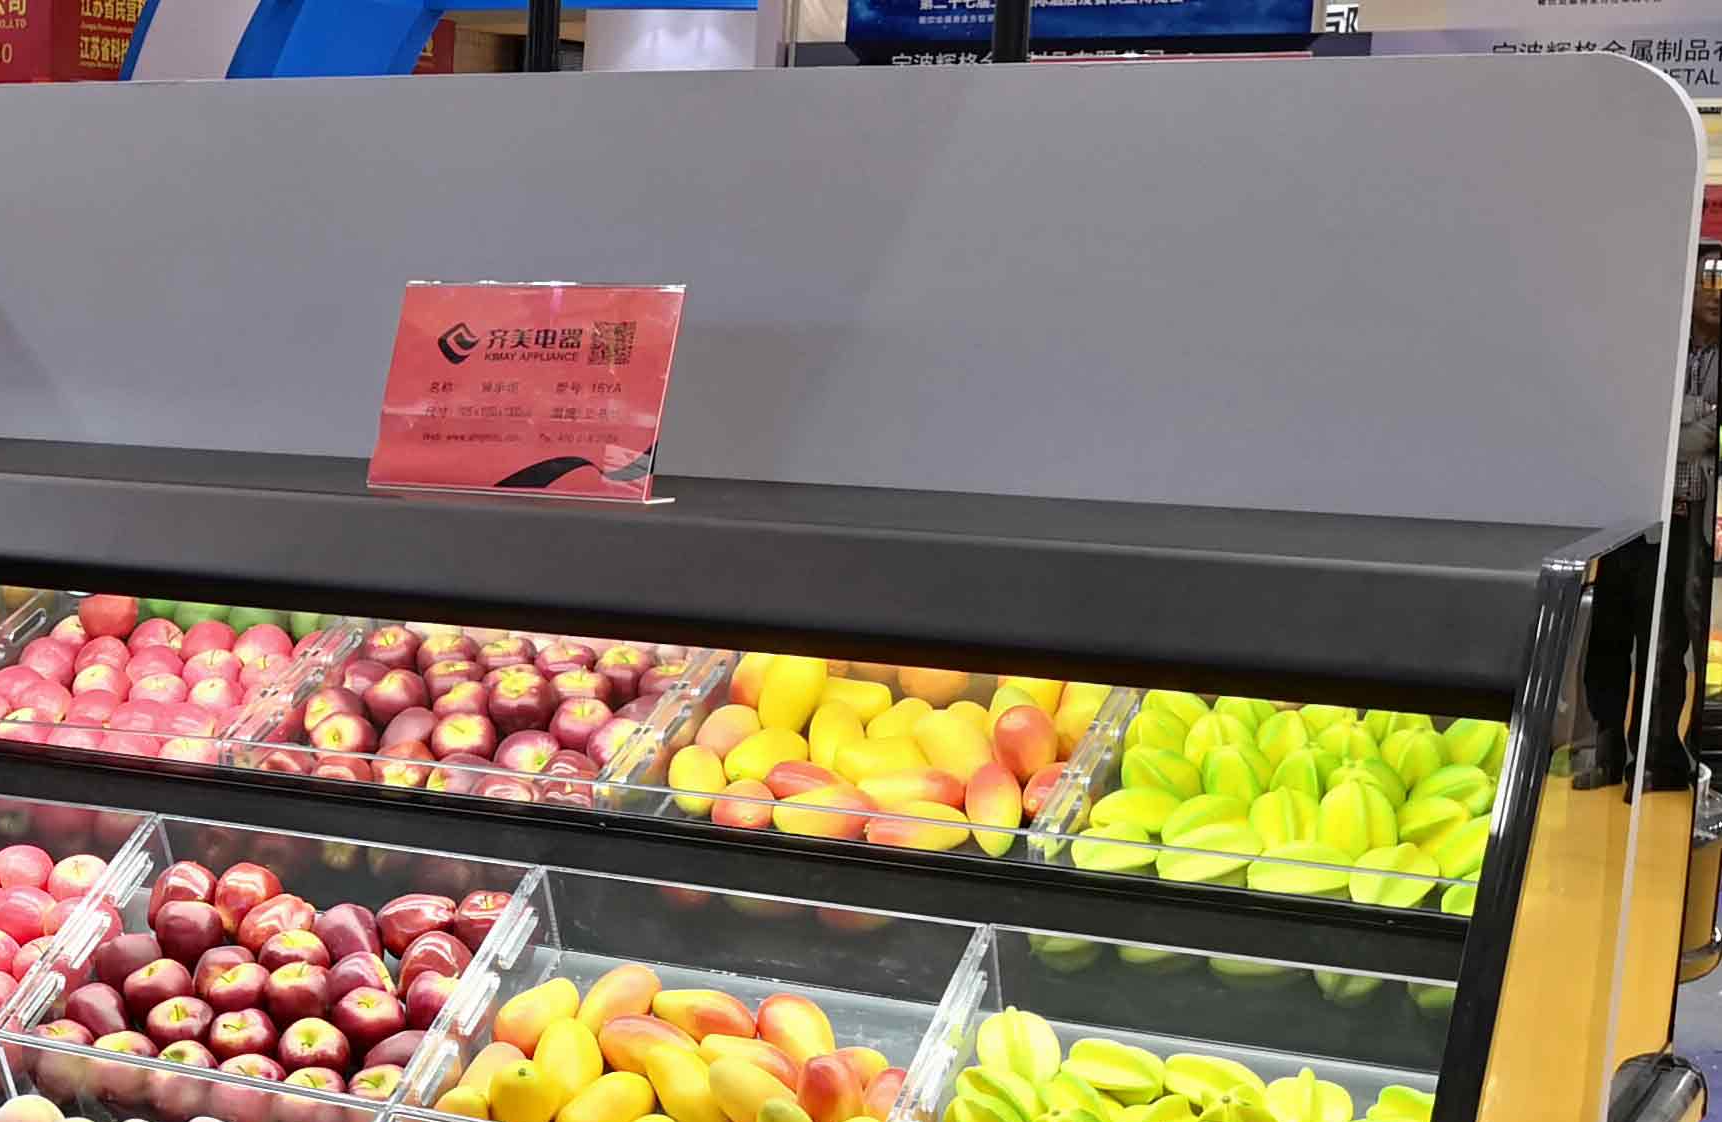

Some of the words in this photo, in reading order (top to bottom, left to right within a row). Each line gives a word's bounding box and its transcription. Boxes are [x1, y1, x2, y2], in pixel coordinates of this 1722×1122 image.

[486, 328, 583, 350] 齐美电器
[519, 351, 579, 362] APPLIANCE
